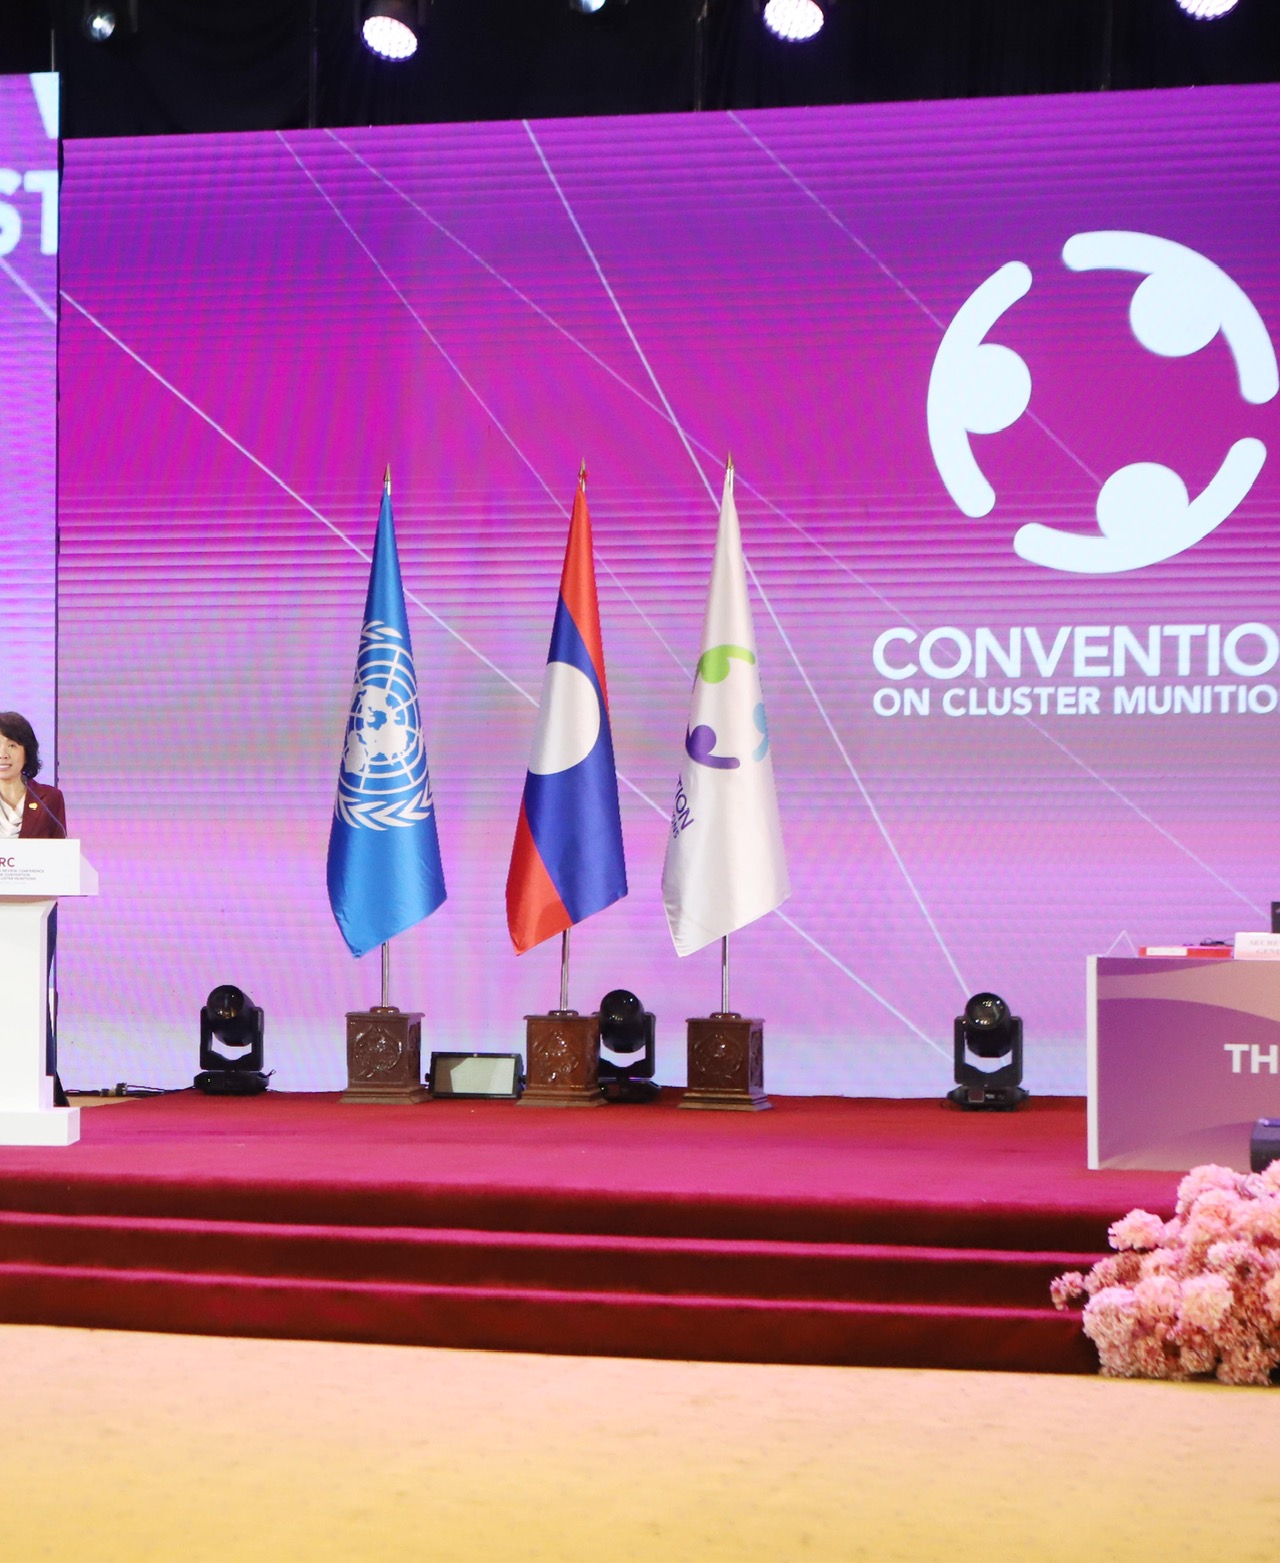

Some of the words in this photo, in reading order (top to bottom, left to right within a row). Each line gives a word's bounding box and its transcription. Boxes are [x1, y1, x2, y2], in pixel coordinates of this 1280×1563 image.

[872, 622, 1280, 680] CONVENTIO
[872, 687, 931, 717] ON
[942, 686, 1101, 717] CLUSTER
[1113, 684, 1279, 716] MUNITIO
[1223, 1043, 1279, 1074] TH
